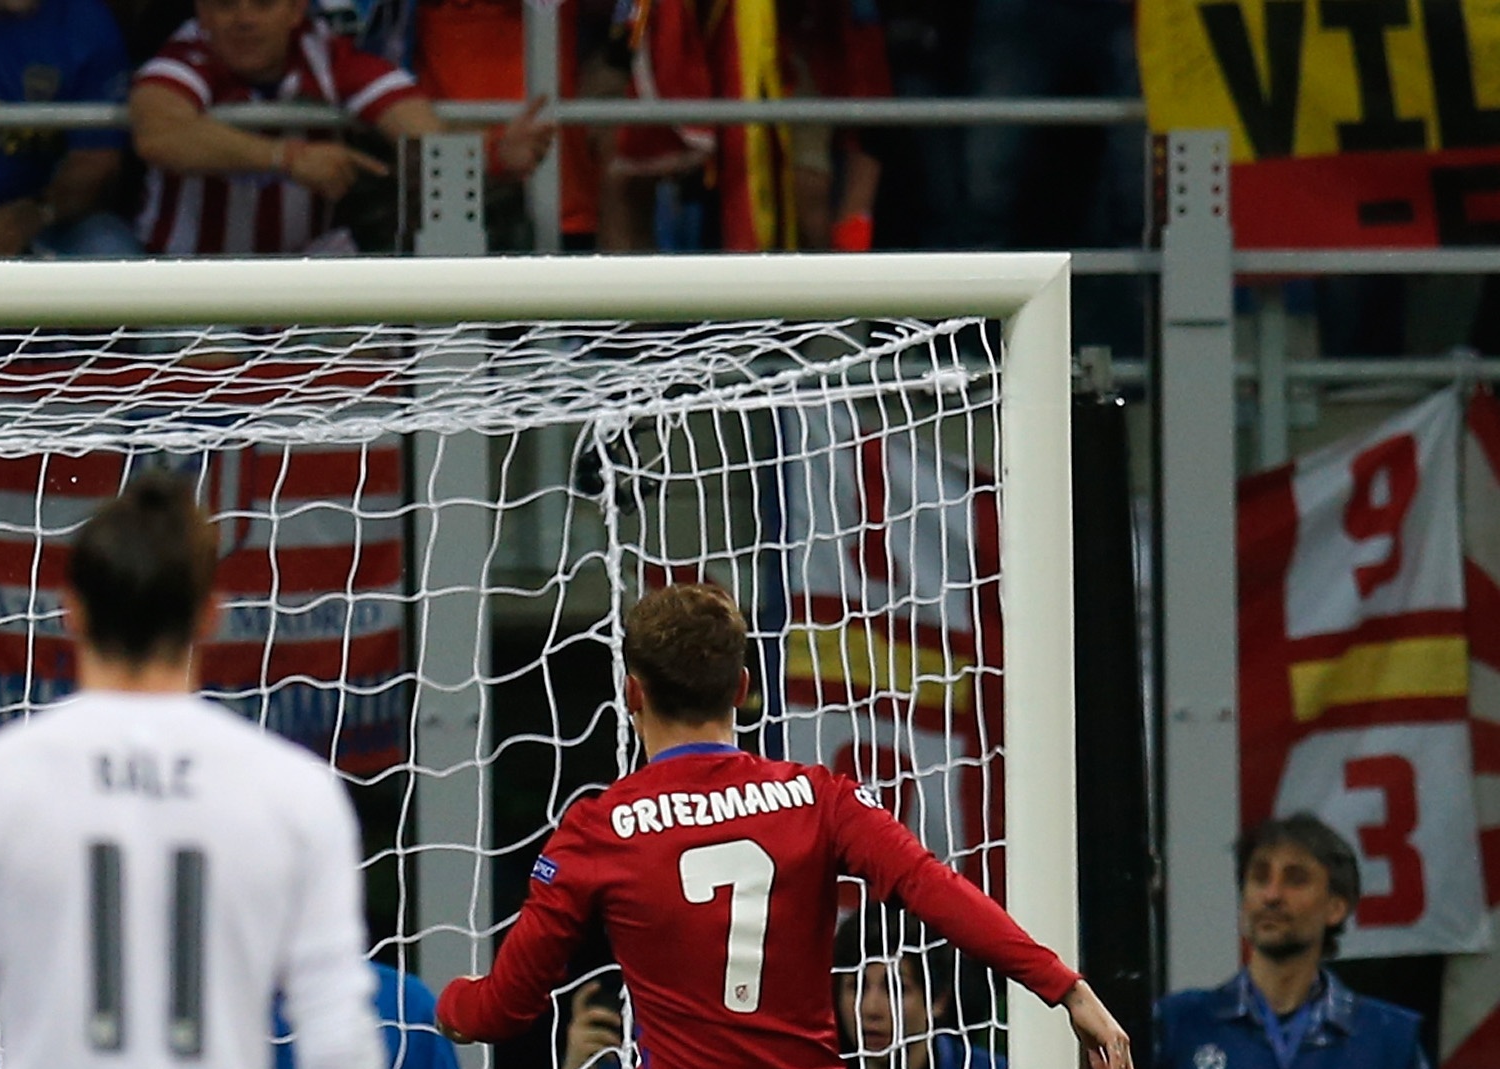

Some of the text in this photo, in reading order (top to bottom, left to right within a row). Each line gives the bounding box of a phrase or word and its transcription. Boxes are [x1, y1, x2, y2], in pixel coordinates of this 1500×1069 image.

[1344, 433, 1419, 599] 9
[611, 775, 815, 838] GRIEZMANN
[1344, 754, 1425, 928] 3
[85, 838, 208, 1060] 11
[679, 839, 775, 1013] 7
